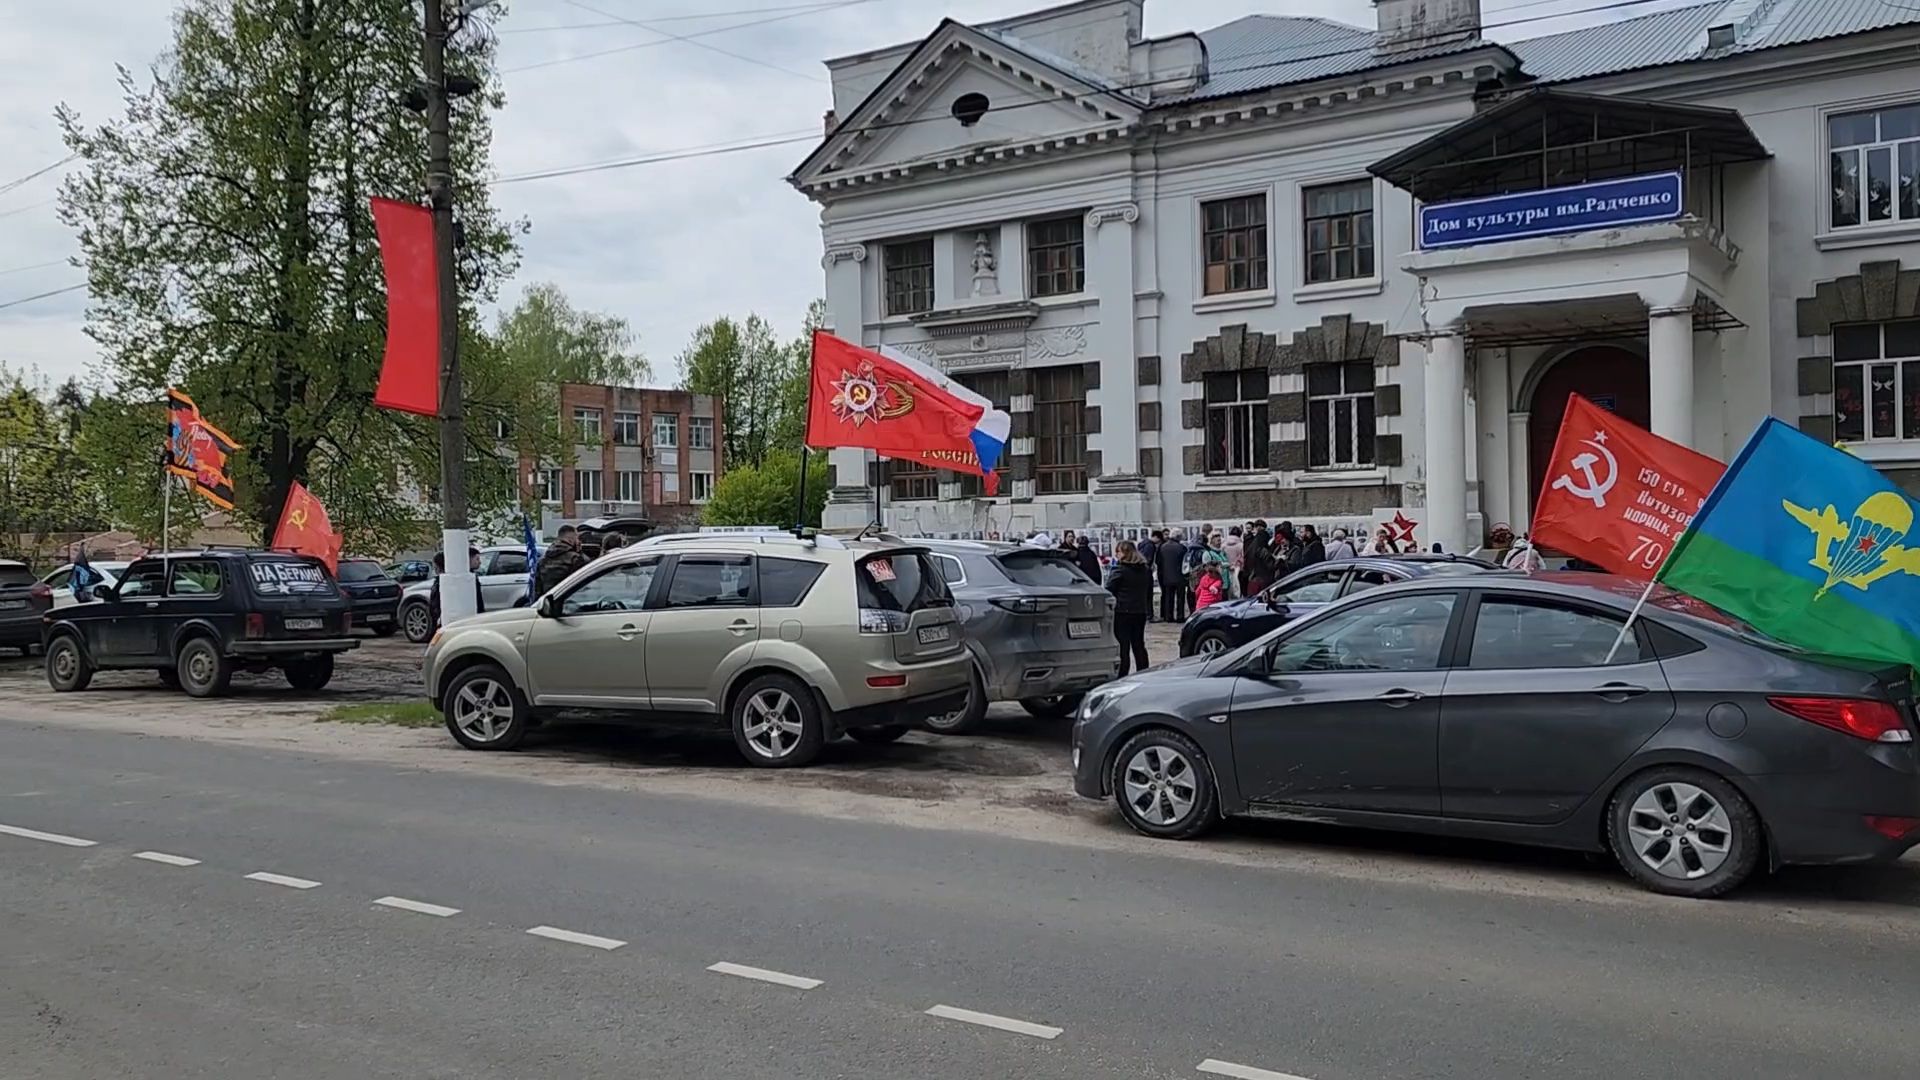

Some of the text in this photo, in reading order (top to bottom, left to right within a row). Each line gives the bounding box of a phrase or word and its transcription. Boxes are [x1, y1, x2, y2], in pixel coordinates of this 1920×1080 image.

[1426, 219, 1460, 236] Дом
[1467, 207, 1549, 231] культуры
[1638, 467, 1660, 488] 150
[1627, 535, 1664, 569] 79
[250, 565, 277, 581] НА
